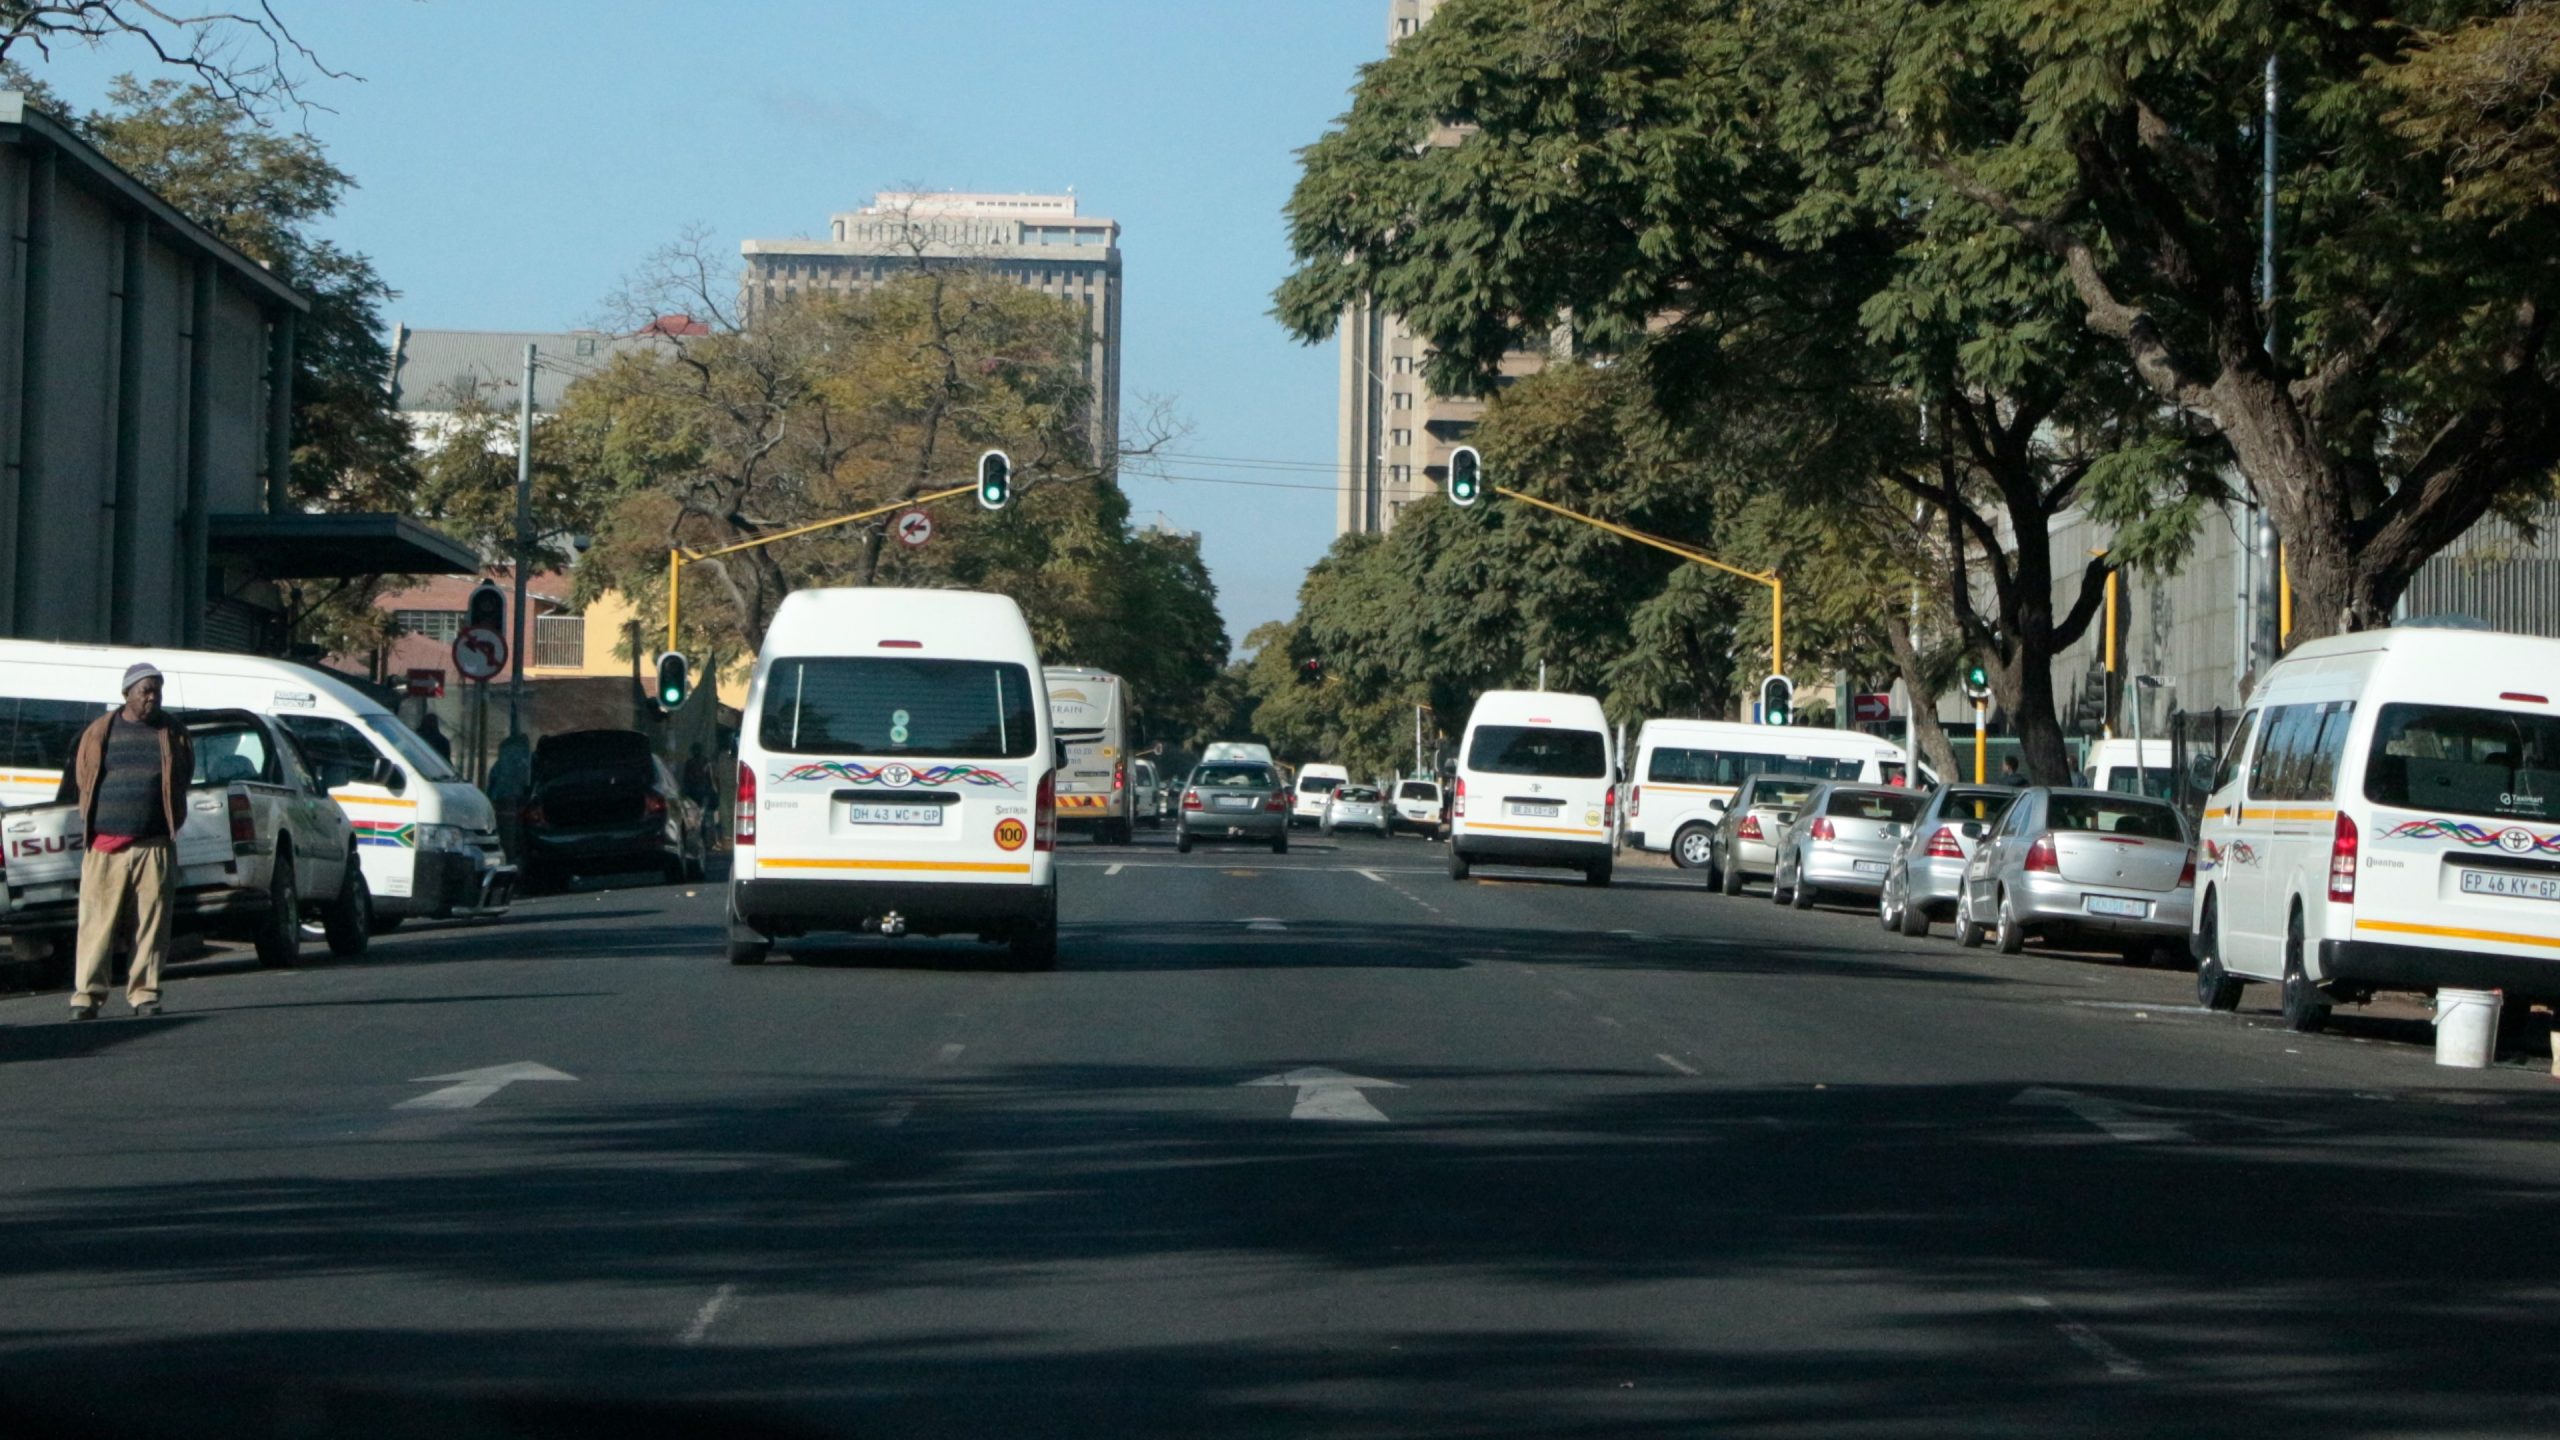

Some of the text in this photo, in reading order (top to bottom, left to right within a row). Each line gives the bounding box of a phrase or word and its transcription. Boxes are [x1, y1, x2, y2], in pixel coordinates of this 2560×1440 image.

[1050, 705, 1083, 714] TRAIN
[853, 808, 939, 822] DH 43 WC GP
[1000, 828, 1022, 841] 100
[11, 833, 84, 858] ISUZ
[2465, 873, 2557, 897] FP 46 KY GP
